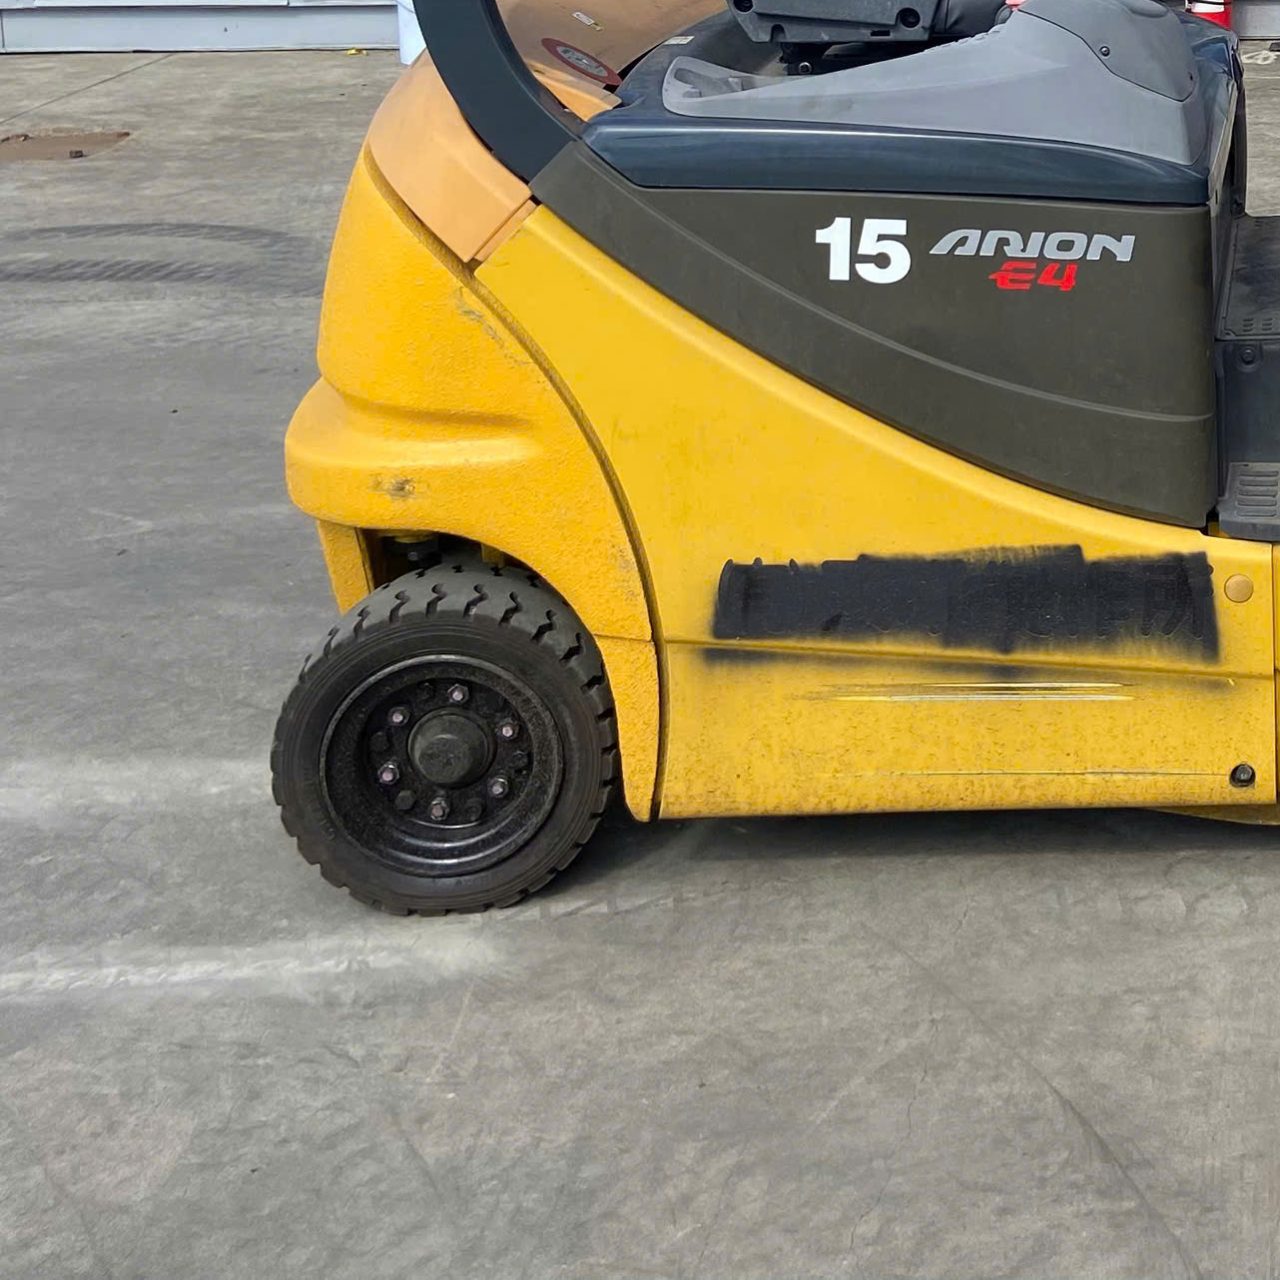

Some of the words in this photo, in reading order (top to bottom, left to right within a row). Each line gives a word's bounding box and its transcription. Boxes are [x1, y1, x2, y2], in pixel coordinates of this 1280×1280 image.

[815, 216, 912, 285] 15
[929, 229, 1136, 263] ARION
[987, 260, 1080, 292] E4
